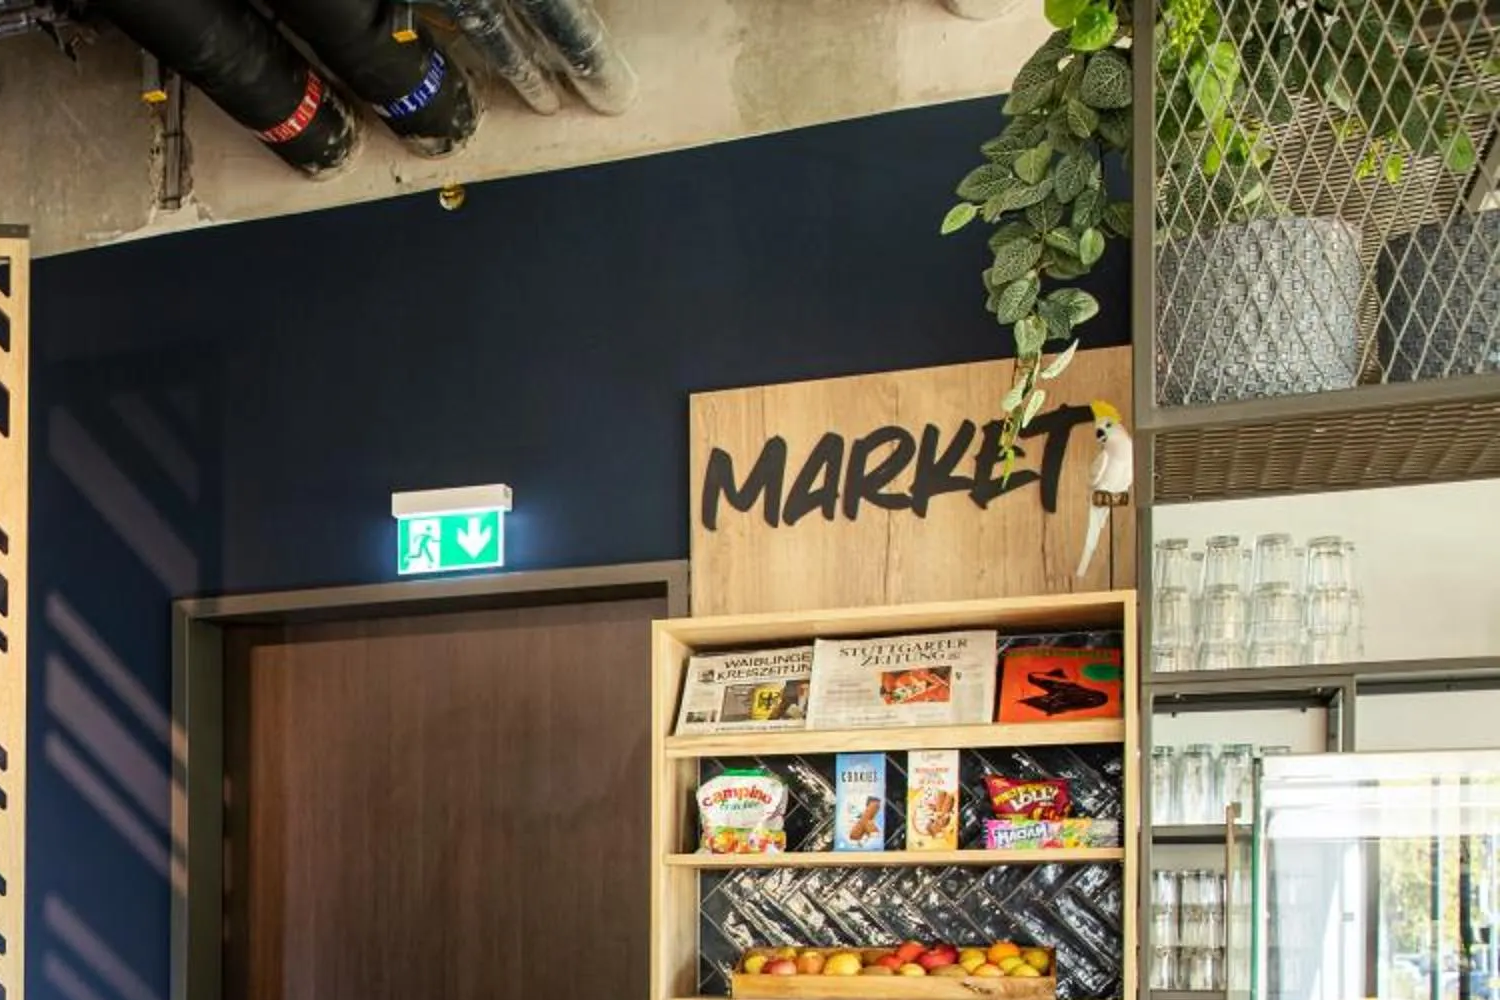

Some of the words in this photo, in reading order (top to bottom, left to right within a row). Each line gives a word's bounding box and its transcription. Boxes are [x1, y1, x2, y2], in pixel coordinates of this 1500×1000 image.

[701, 403, 1095, 532] MARKET
[838, 638, 968, 658] STUTTGARTER
[724, 651, 812, 669] WAIBLINGE
[861, 650, 946, 667] ZEITUNG
[716, 664, 812, 681] KREISZEITUN
